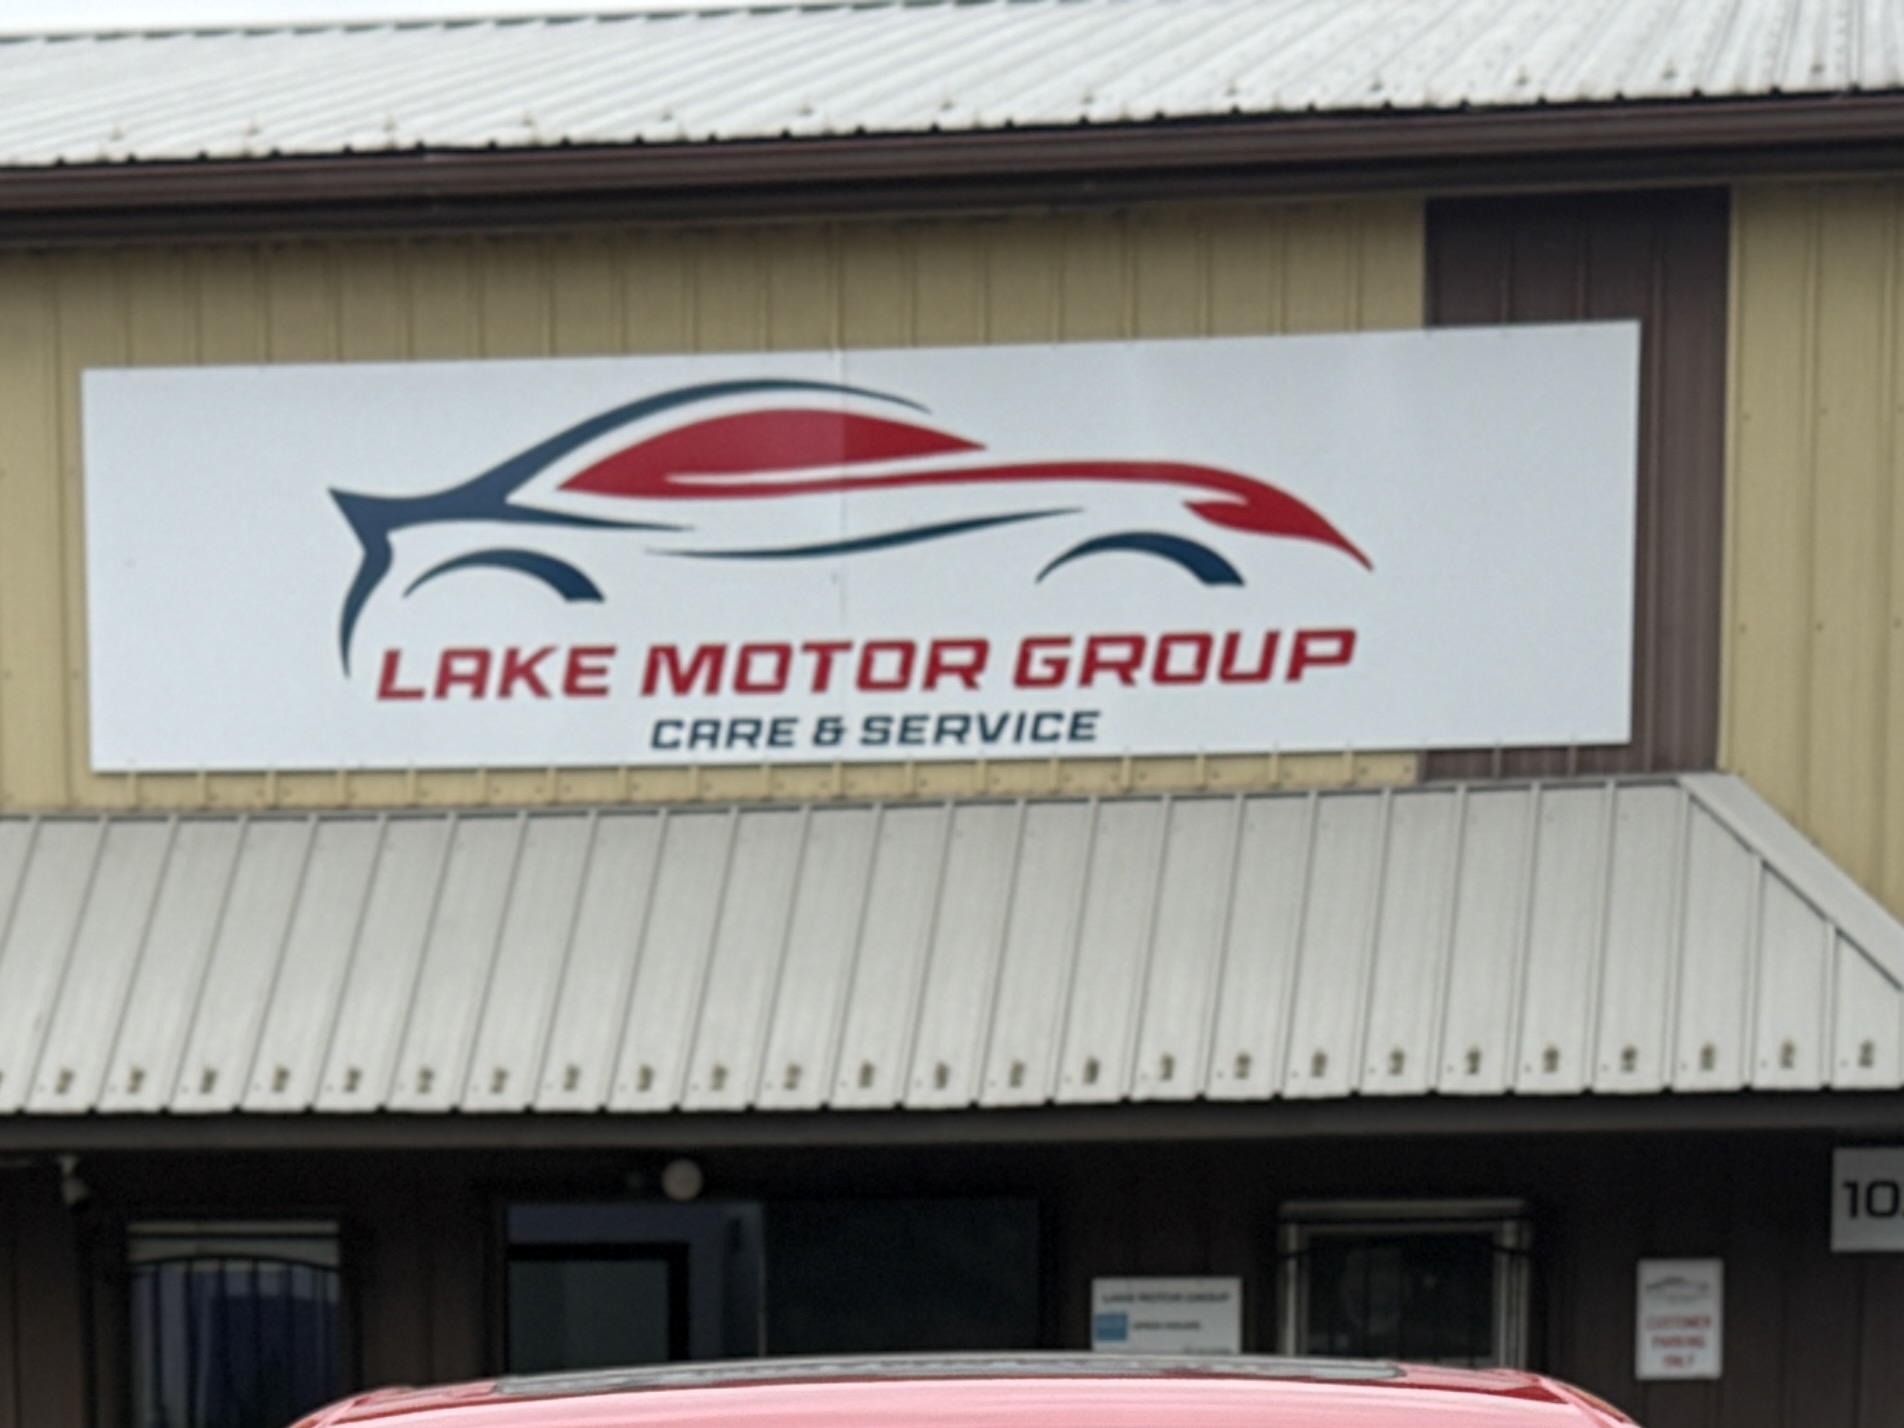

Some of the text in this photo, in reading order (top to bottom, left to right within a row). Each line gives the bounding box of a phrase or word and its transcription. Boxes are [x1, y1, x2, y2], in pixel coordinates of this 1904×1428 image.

[377, 628, 1357, 701] LAKE MOTOR GROUP
[651, 710, 1101, 750] CARE & SERVICE
